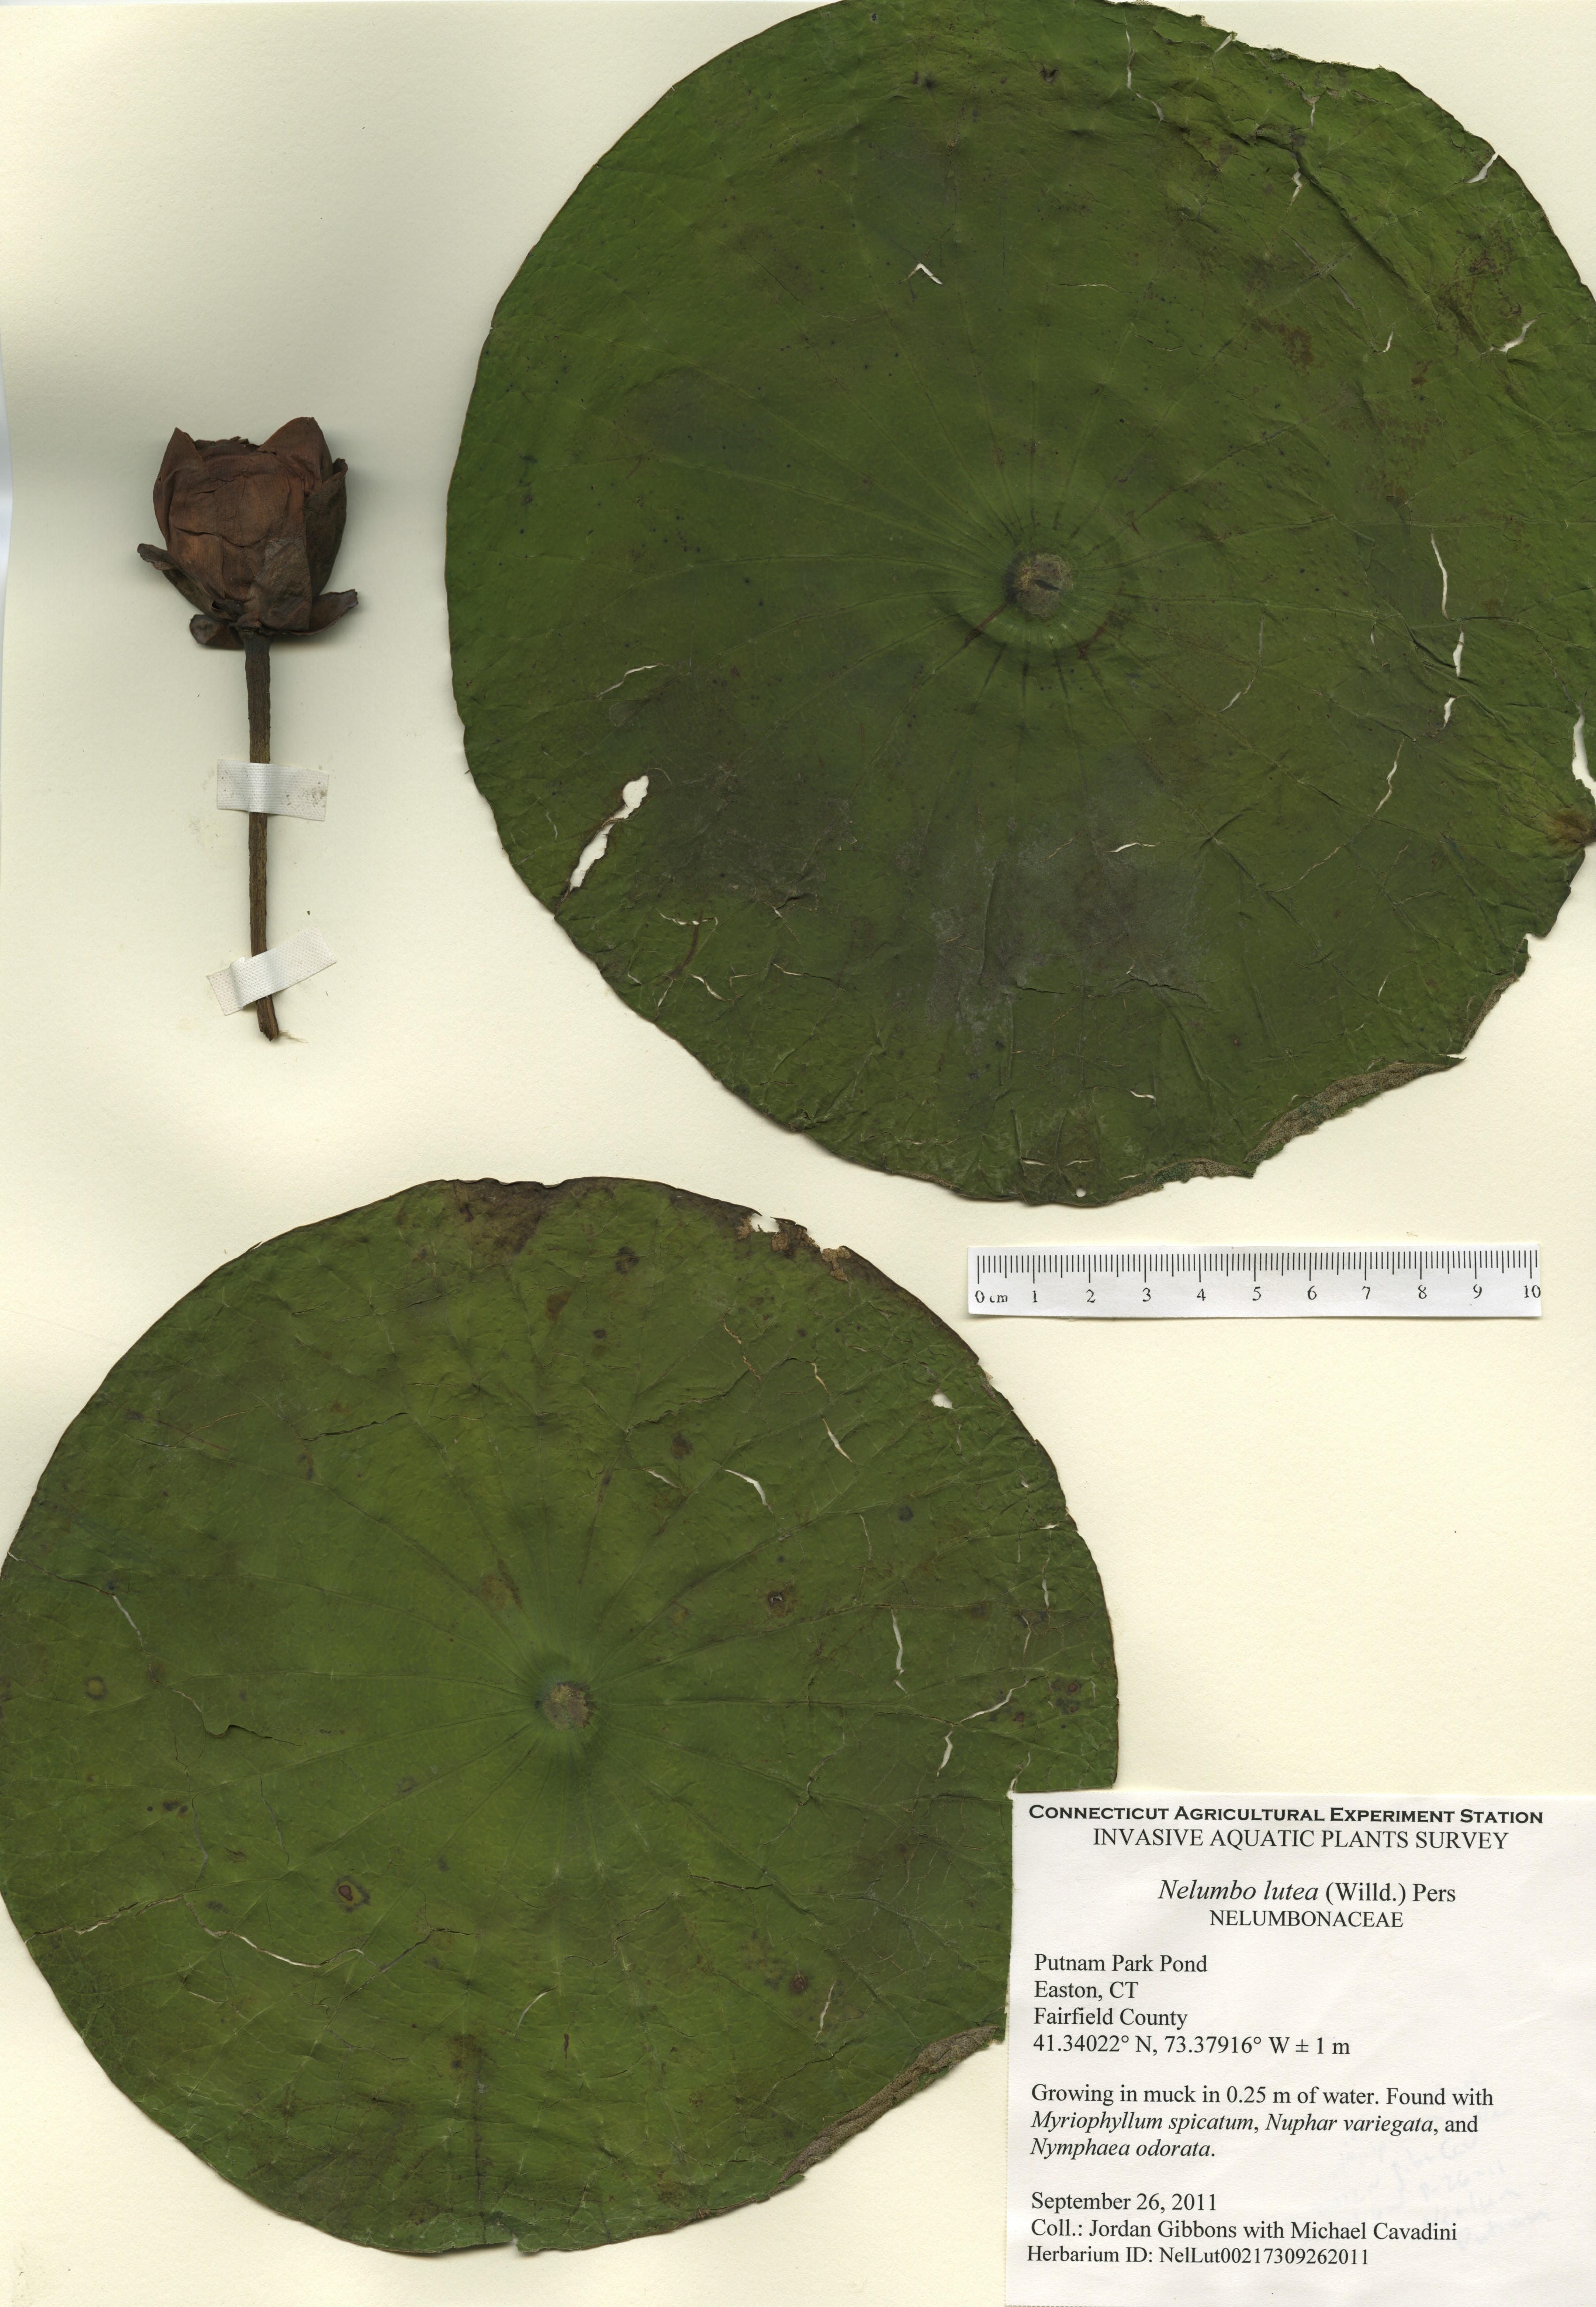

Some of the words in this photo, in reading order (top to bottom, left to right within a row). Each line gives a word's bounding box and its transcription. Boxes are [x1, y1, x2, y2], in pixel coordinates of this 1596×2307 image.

[975, 1290, 985, 1303] 0
[1033, 1290, 1038, 1303] 1
[1086, 1289, 1096, 1303] 2
[1142, 1287, 1151, 1302] 3
[1197, 1288, 1206, 1301] 4
[1252, 1286, 1262, 1301] 5
[1307, 1286, 1317, 1300] 6
[1362, 1286, 1370, 1300] 7
[1418, 1285, 1427, 1299] 8
[1473, 1284, 1482, 1299] 9
[1524, 1285, 1541, 1298] 10
[1093, 1828, 1204, 1846] INVASIVE
[1209, 1829, 1314, 1851] AQUATIC
[1321, 1830, 1408, 1848] PLANTS
[1416, 1831, 1509, 1849] SURVEY
[1158, 1879, 1256, 1900] Nelumbo
[1264, 1880, 1318, 1900] lutea
[1326, 1882, 1406, 1906] (Willd.)
[1413, 1883, 1456, 1902] Pers
[1210, 1910, 1403, 1927] NELUMBONACEAE
[1034, 1953, 1106, 1971] Putnam
[1112, 1954, 1153, 1972] Park
[1159, 1955, 1207, 1972] Pond
[1034, 1981, 1102, 2002] Easton,
[1109, 1981, 1138, 1998] CT
[1034, 2007, 1114, 2025] Fairfield
[1120, 2008, 1188, 2030] County
[1033, 2034, 1129, 2052] 41.34022°
[1135, 2035, 1157, 2056] N,
[1165, 2035, 1261, 2053] 73.37916°
[1268, 2037, 1290, 2054] W
[1317, 2037, 1323, 2054] 1
[1332, 2042, 1350, 2054] m
[1031, 2084, 1114, 2106] Growing
[1120, 2084, 1137, 2102] in
[1144, 2085, 1196, 2103] muck
[1202, 2085, 1220, 2103] in
[1227, 2086, 1266, 2103] 0.25
[1272, 2091, 1291, 2103] m
[1297, 2086, 1319, 2103] of
[1322, 2089, 1378, 2104] water.
[1386, 2088, 1445, 2105] Found
[1452, 2088, 1493, 2105] with
[1030, 2111, 1162, 2133] Myriophyllum
[1168, 2113, 1258, 2134] spicatum,
[1265, 2113, 1338, 2135] Nuphar
[1343, 2115, 1438, 2136] variegata,
[1445, 2115, 1478, 2133] and
[1030, 2138, 1130, 2160] Nymphaea
[1136, 2139, 1215, 2157] odorata.
[1032, 2192, 1131, 2214] September
[1137, 2193, 1165, 2214] 26,
[1172, 2194, 1216, 2210] 2011
[1031, 2219, 1082, 2236] Coll.:
[1089, 2219, 1151, 2237] Jordan
[1158, 2220, 1237, 2238] Gibbons
[1243, 2221, 1285, 2238] with
[1291, 2221, 1366, 2239] Michael
[1373, 2223, 1457, 2240] Cavadini
[1028, 2246, 1119, 2262] Herbarium
[1126, 2247, 1152, 2262] ID:
[1159, 2246, 1367, 2264] NelLut00217309262011
